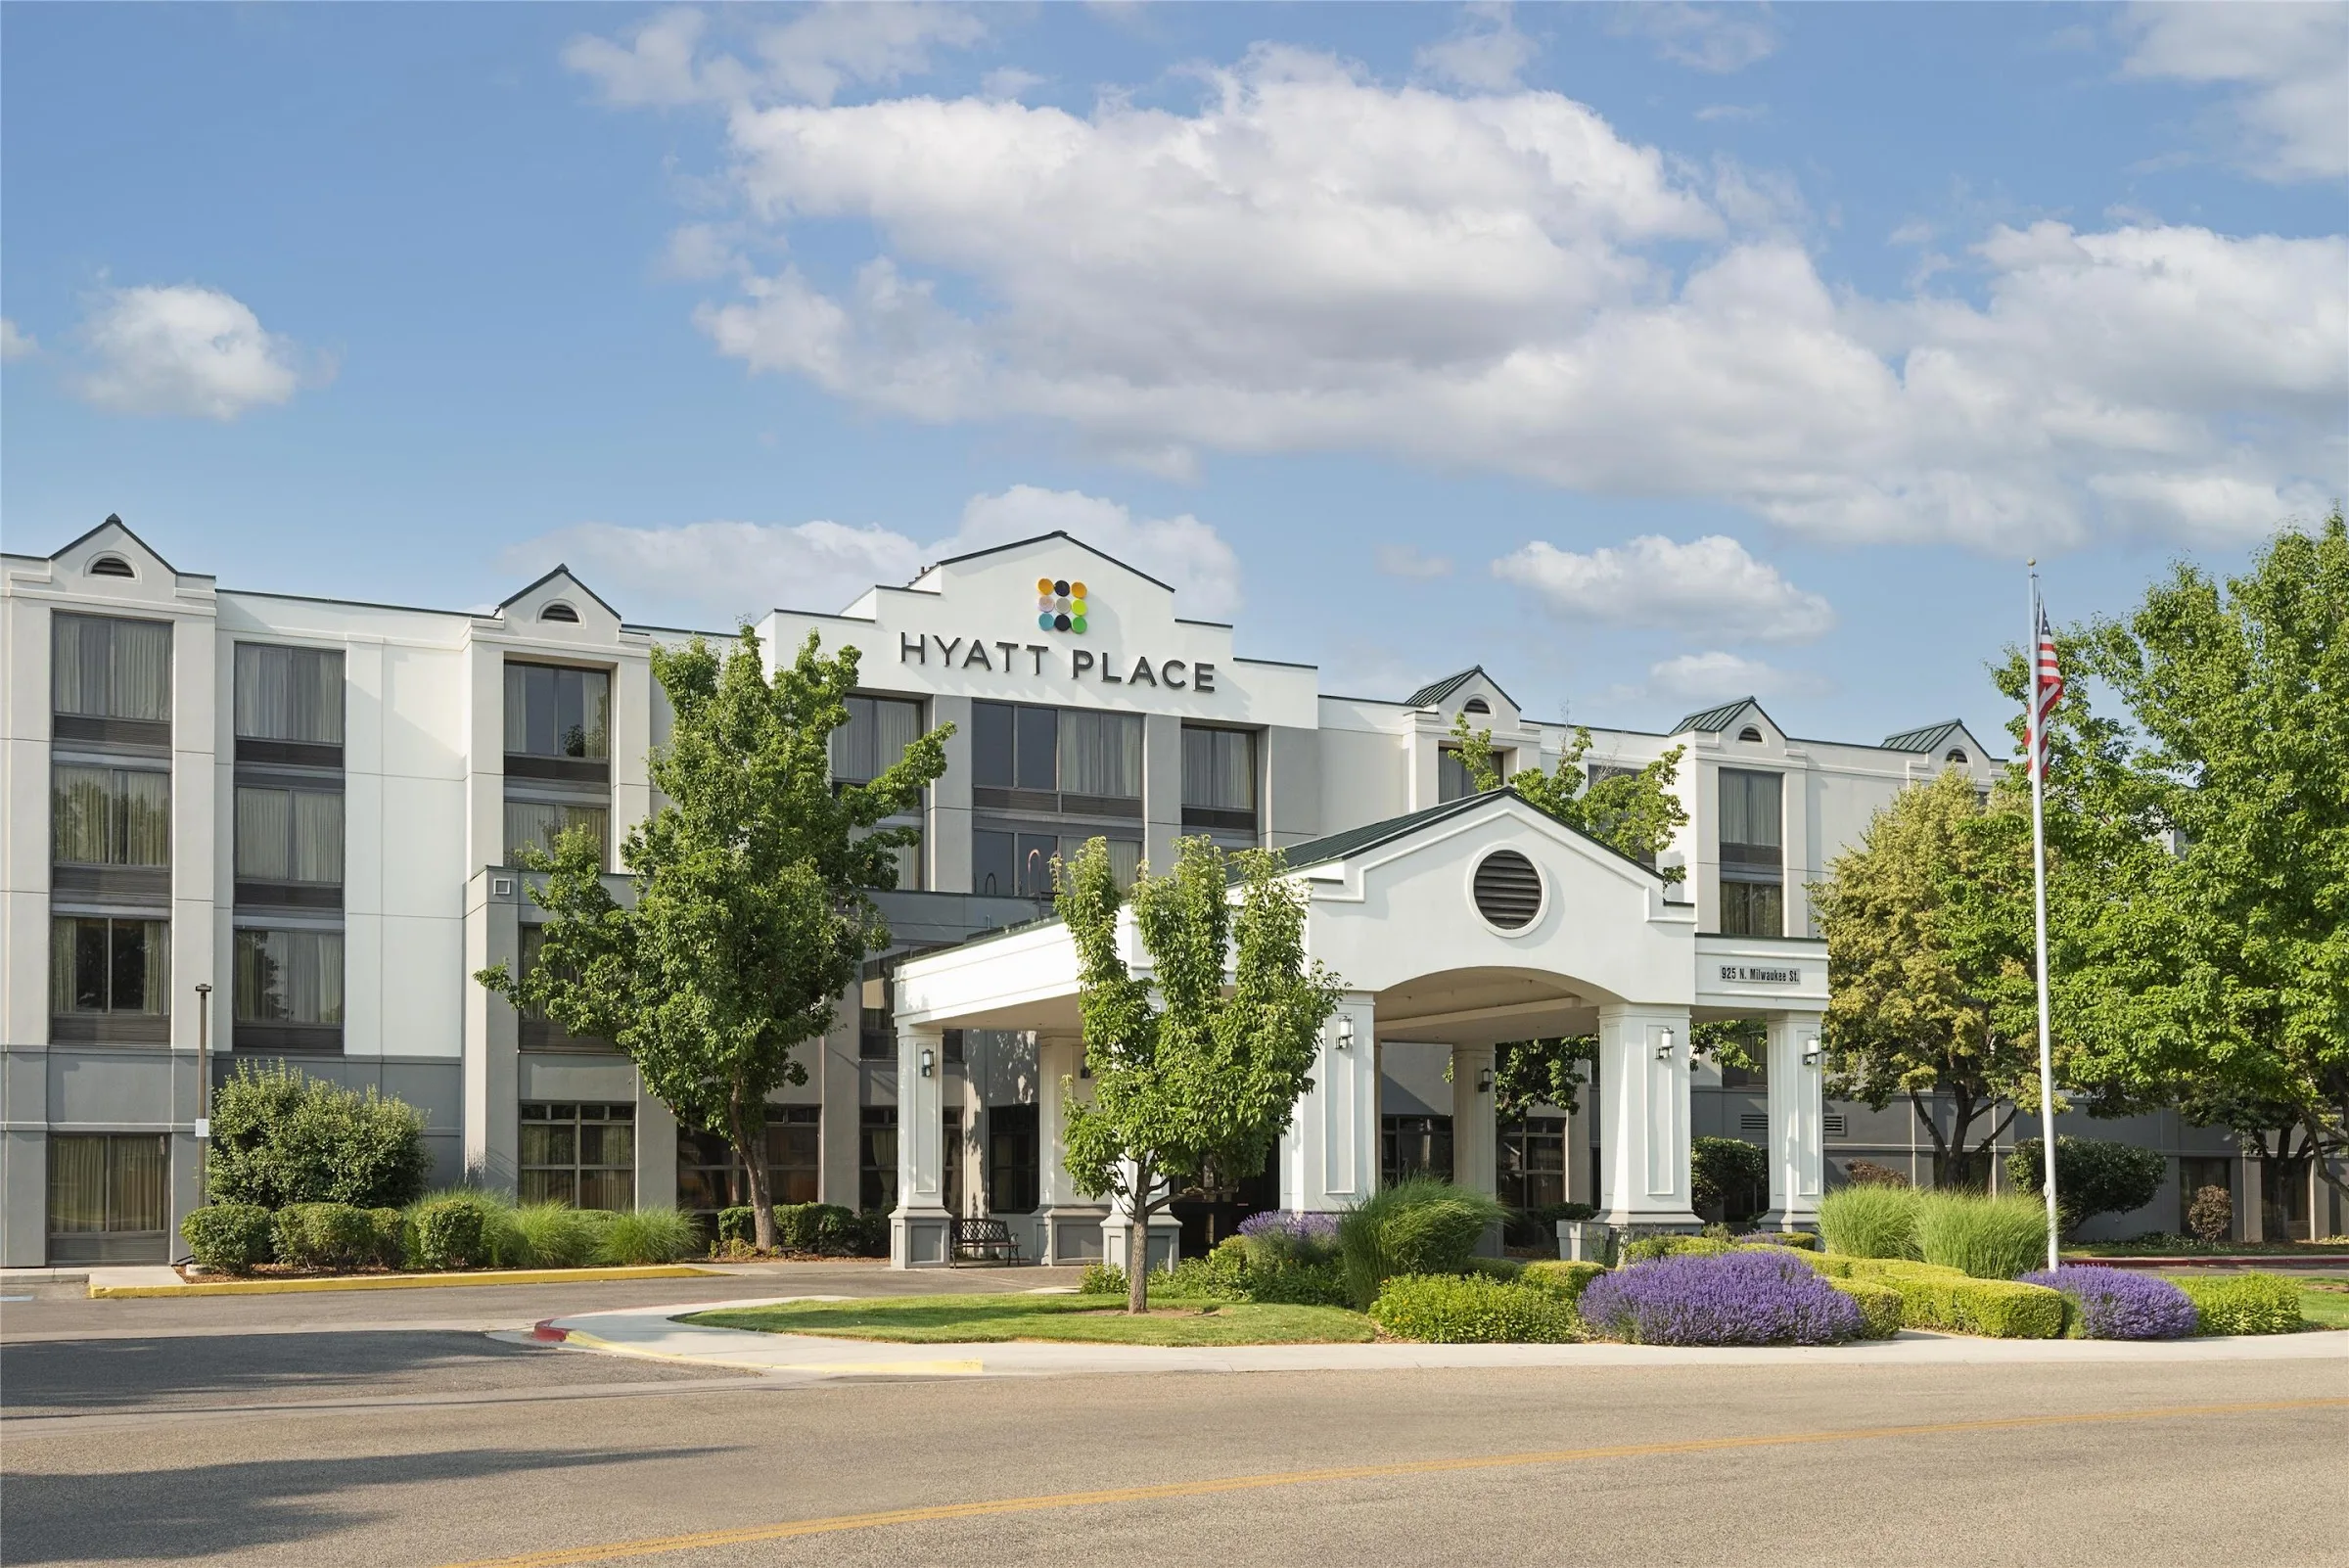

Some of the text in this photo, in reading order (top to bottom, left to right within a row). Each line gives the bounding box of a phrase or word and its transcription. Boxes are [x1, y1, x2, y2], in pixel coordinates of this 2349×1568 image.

[900, 631, 1216, 692] HYATT PLACE
[1722, 967, 1800, 982] 925 N. Milwaukee St.
